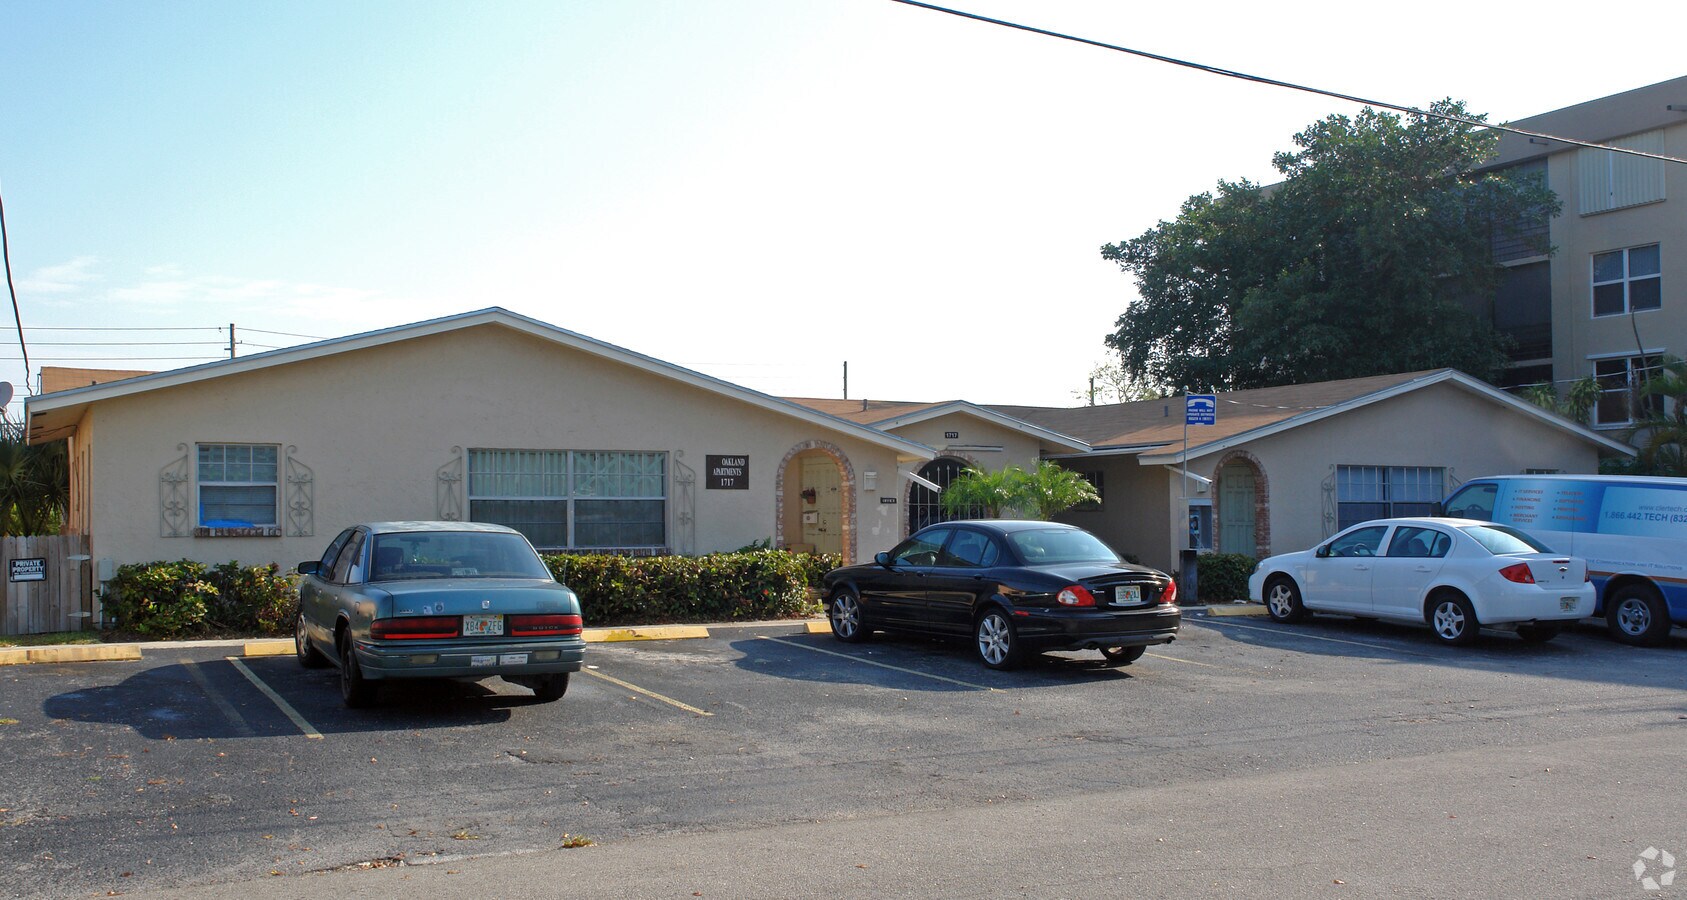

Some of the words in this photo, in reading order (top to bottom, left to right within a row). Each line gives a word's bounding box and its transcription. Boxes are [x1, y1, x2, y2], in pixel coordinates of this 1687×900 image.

[721, 458, 745, 466] OAKLAND
[713, 468, 742, 476] APARTMENTS
[721, 478, 734, 486] 1717
[1604, 512, 1668, 522] 1.866.442.TECH
